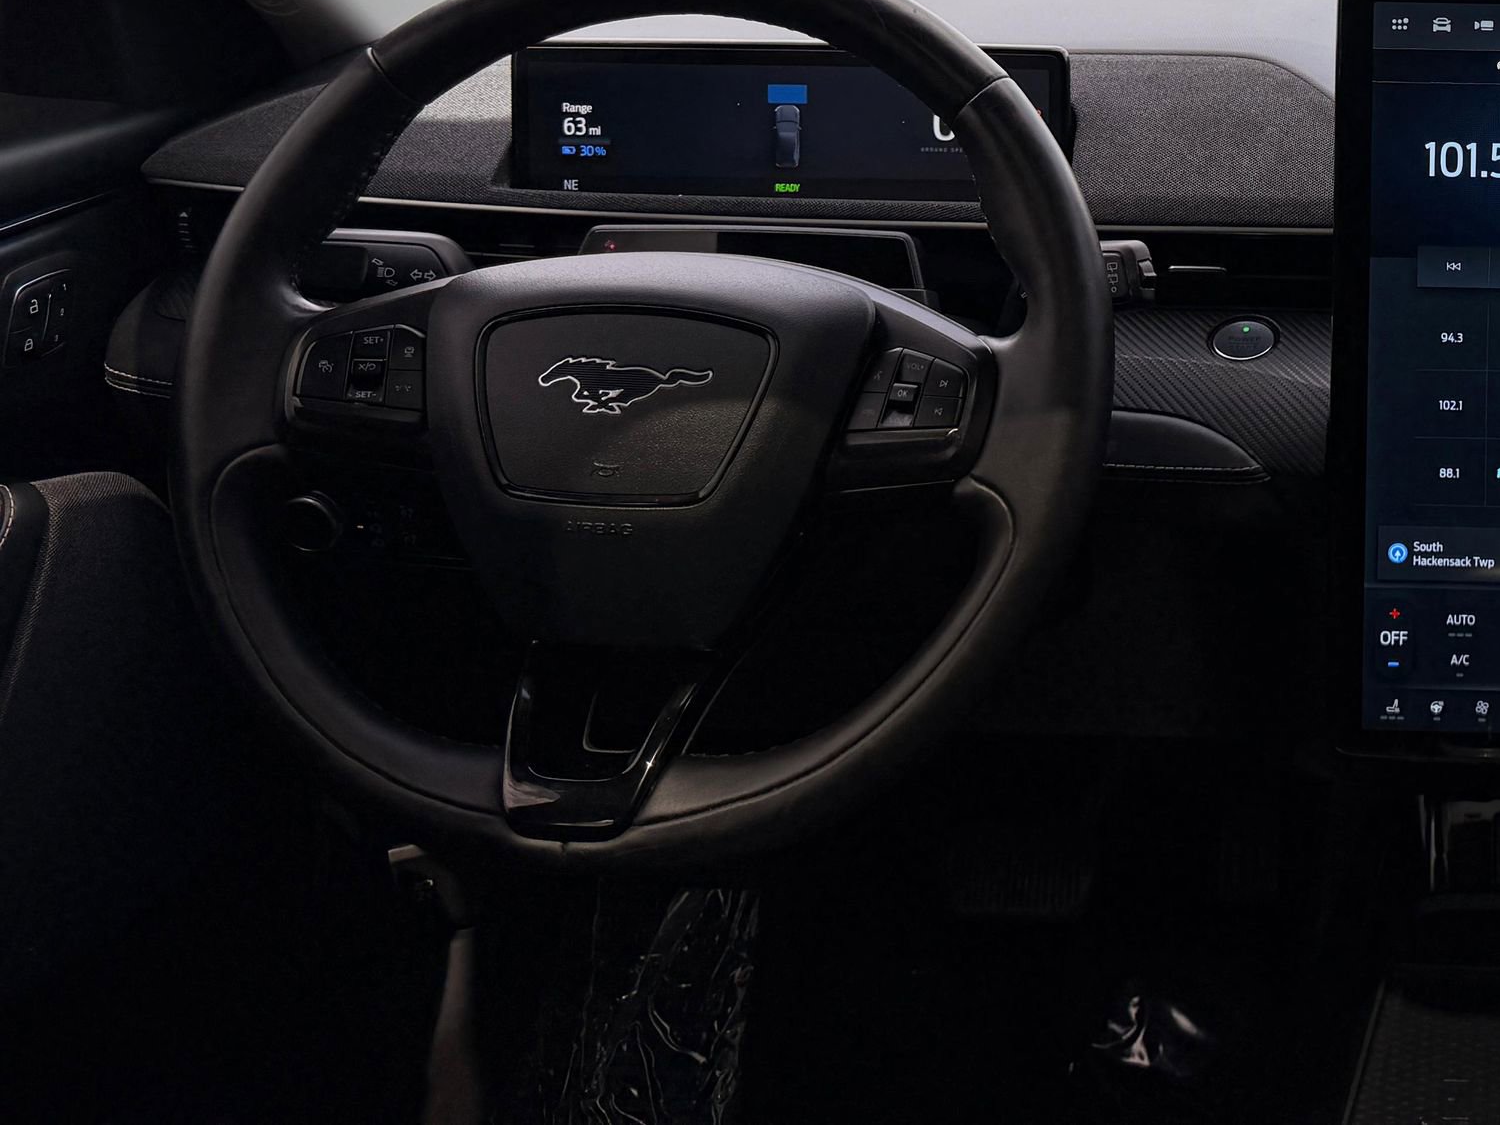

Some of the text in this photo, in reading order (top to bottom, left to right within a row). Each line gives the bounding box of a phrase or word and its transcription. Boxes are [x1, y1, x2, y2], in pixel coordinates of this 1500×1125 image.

[562, 102, 593, 115] Range
[563, 117, 601, 136] 63 mi
[580, 145, 607, 157] 30%
[563, 179, 579, 191] NE
[775, 183, 801, 194] READY
[1440, 332, 1464, 343] 94.3
[897, 389, 910, 398] OK
[1438, 400, 1463, 411] 102.1
[1439, 467, 1460, 479] 88.1
[1413, 541, 1444, 553] South
[1412, 554, 1495, 569] Hackensack Twp
[1446, 614, 1476, 626] AUTO
[1379, 630, 1409, 646] OFF
[1450, 654, 1470, 666] A/C
